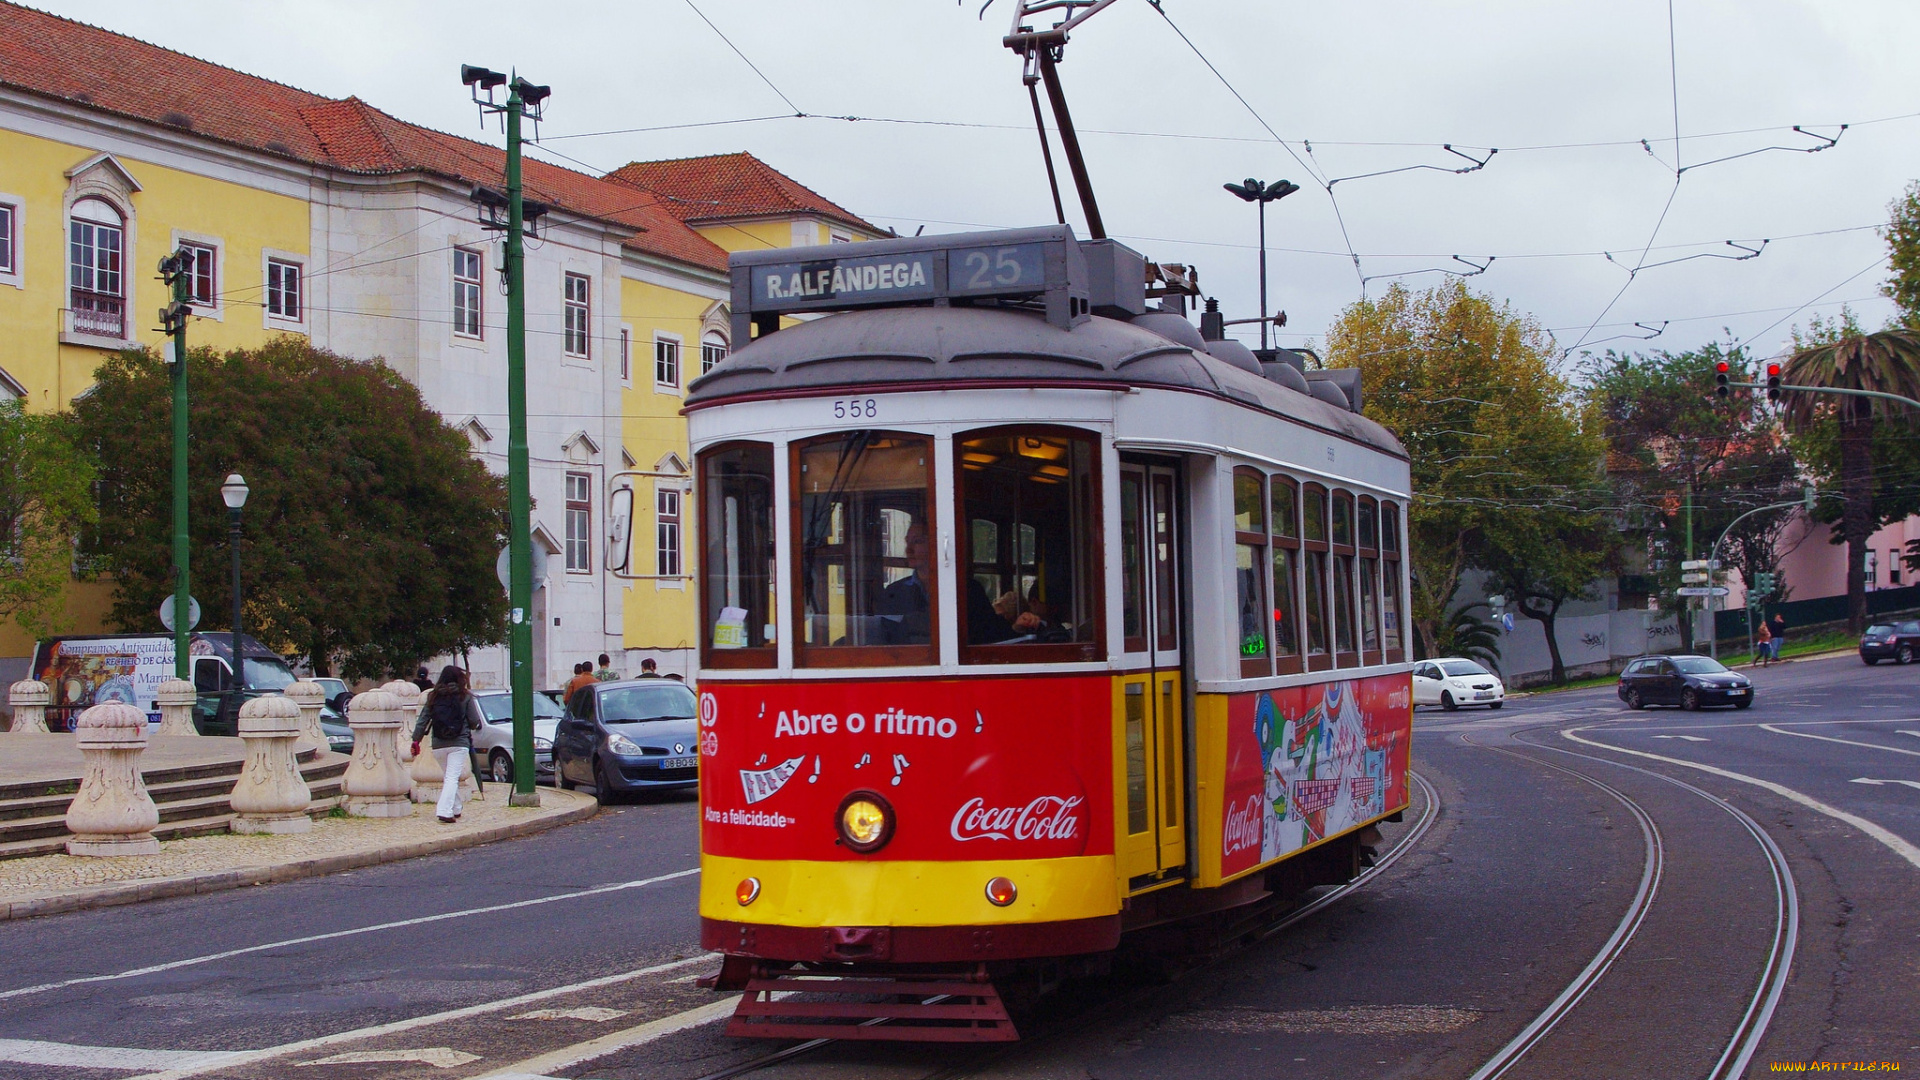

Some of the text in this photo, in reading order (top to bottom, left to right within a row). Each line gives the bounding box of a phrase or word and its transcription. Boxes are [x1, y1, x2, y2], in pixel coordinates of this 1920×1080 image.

[965, 247, 1022, 289] 25
[833, 398, 878, 418] 558
[58, 640, 176, 657] Compramos Antiguidad
[105, 656, 142, 666] RECHEIO
[142, 656, 154, 665] DE
[112, 672, 135, 686] José
[774, 707, 957, 738] Abre o ritmo
[705, 806, 721, 823] Abre
[722, 811, 728, 824] a
[729, 808, 787, 828] felicidade
[950, 795, 1085, 842] Coca-Cola
